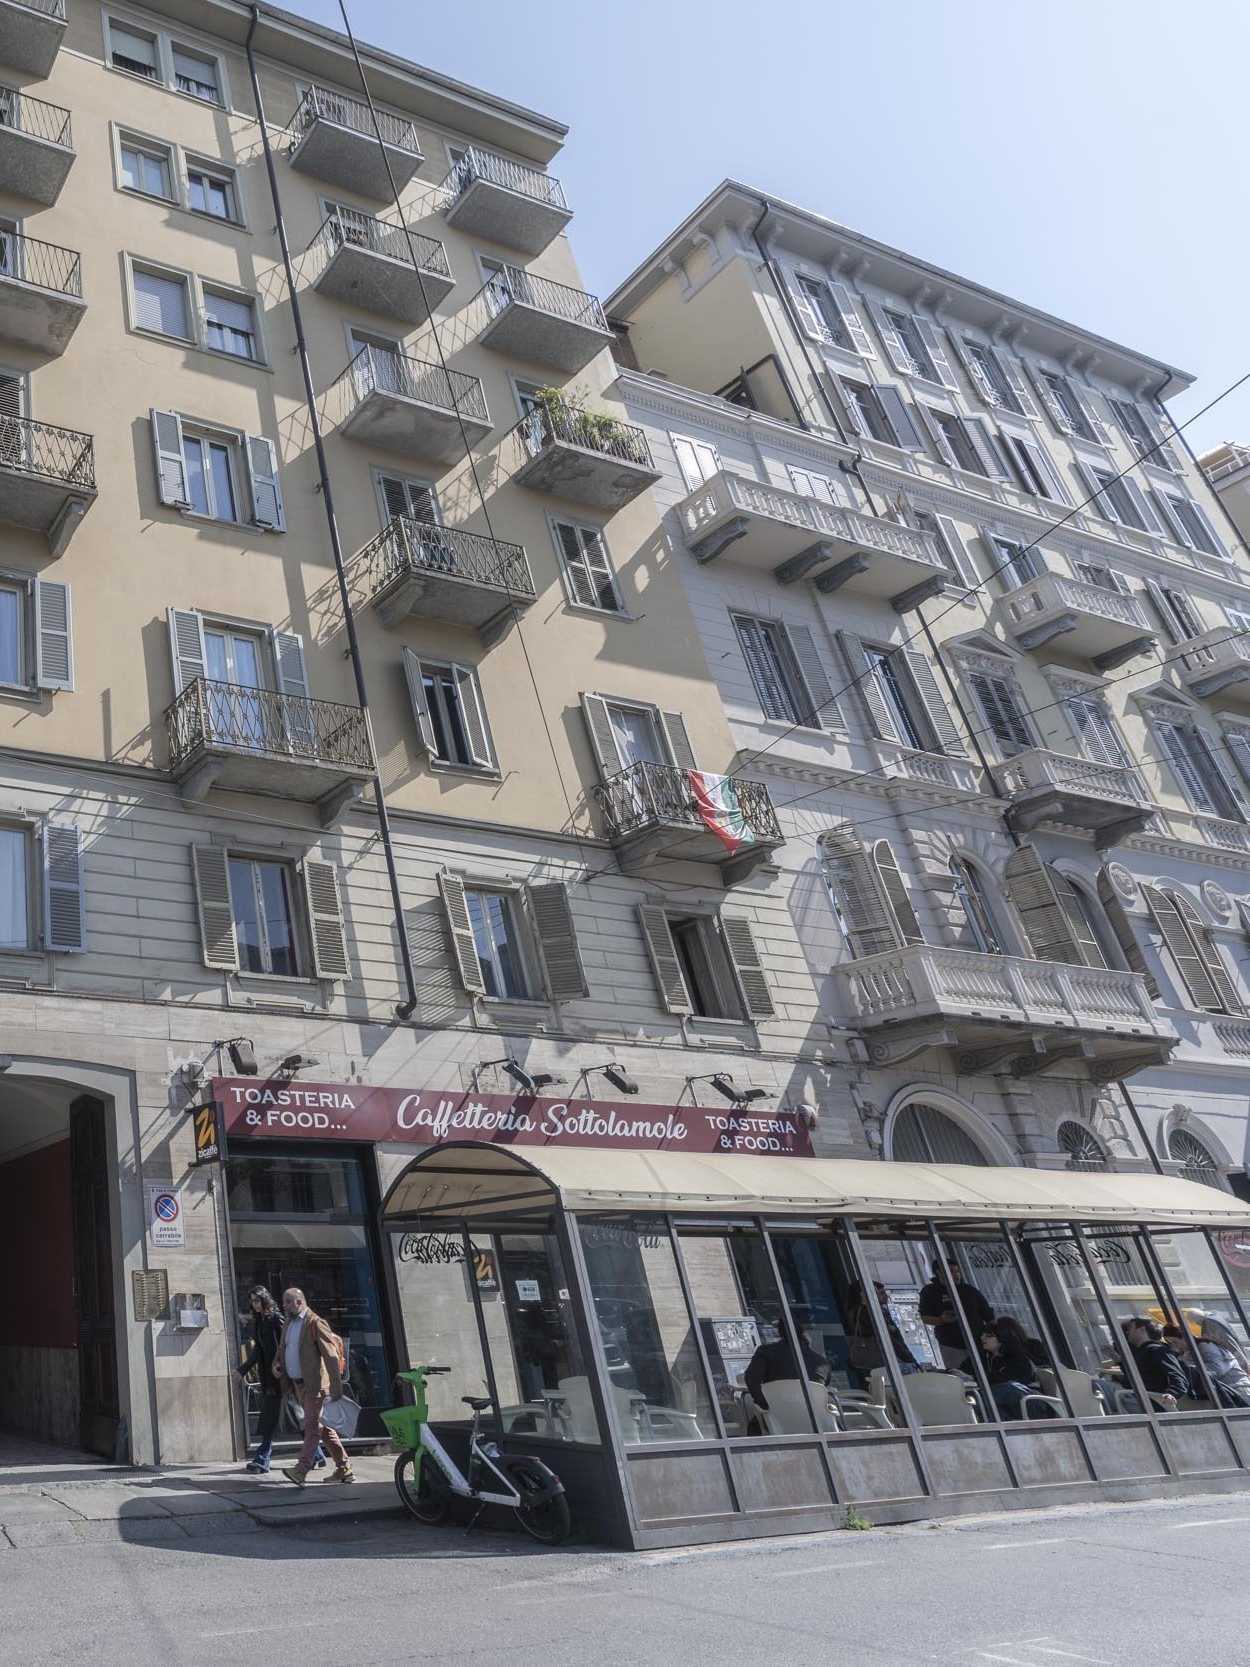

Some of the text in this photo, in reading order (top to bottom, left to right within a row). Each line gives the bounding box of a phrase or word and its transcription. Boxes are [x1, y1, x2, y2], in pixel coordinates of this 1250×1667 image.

[230, 1087, 356, 1109] TOASTERIA
[246, 1109, 347, 1130] & FOOD...
[397, 1094, 687, 1139] Caffetteria Sottolamole
[705, 1115, 797, 1134] TOASTERIA
[720, 1135, 794, 1152] & FOOD...
